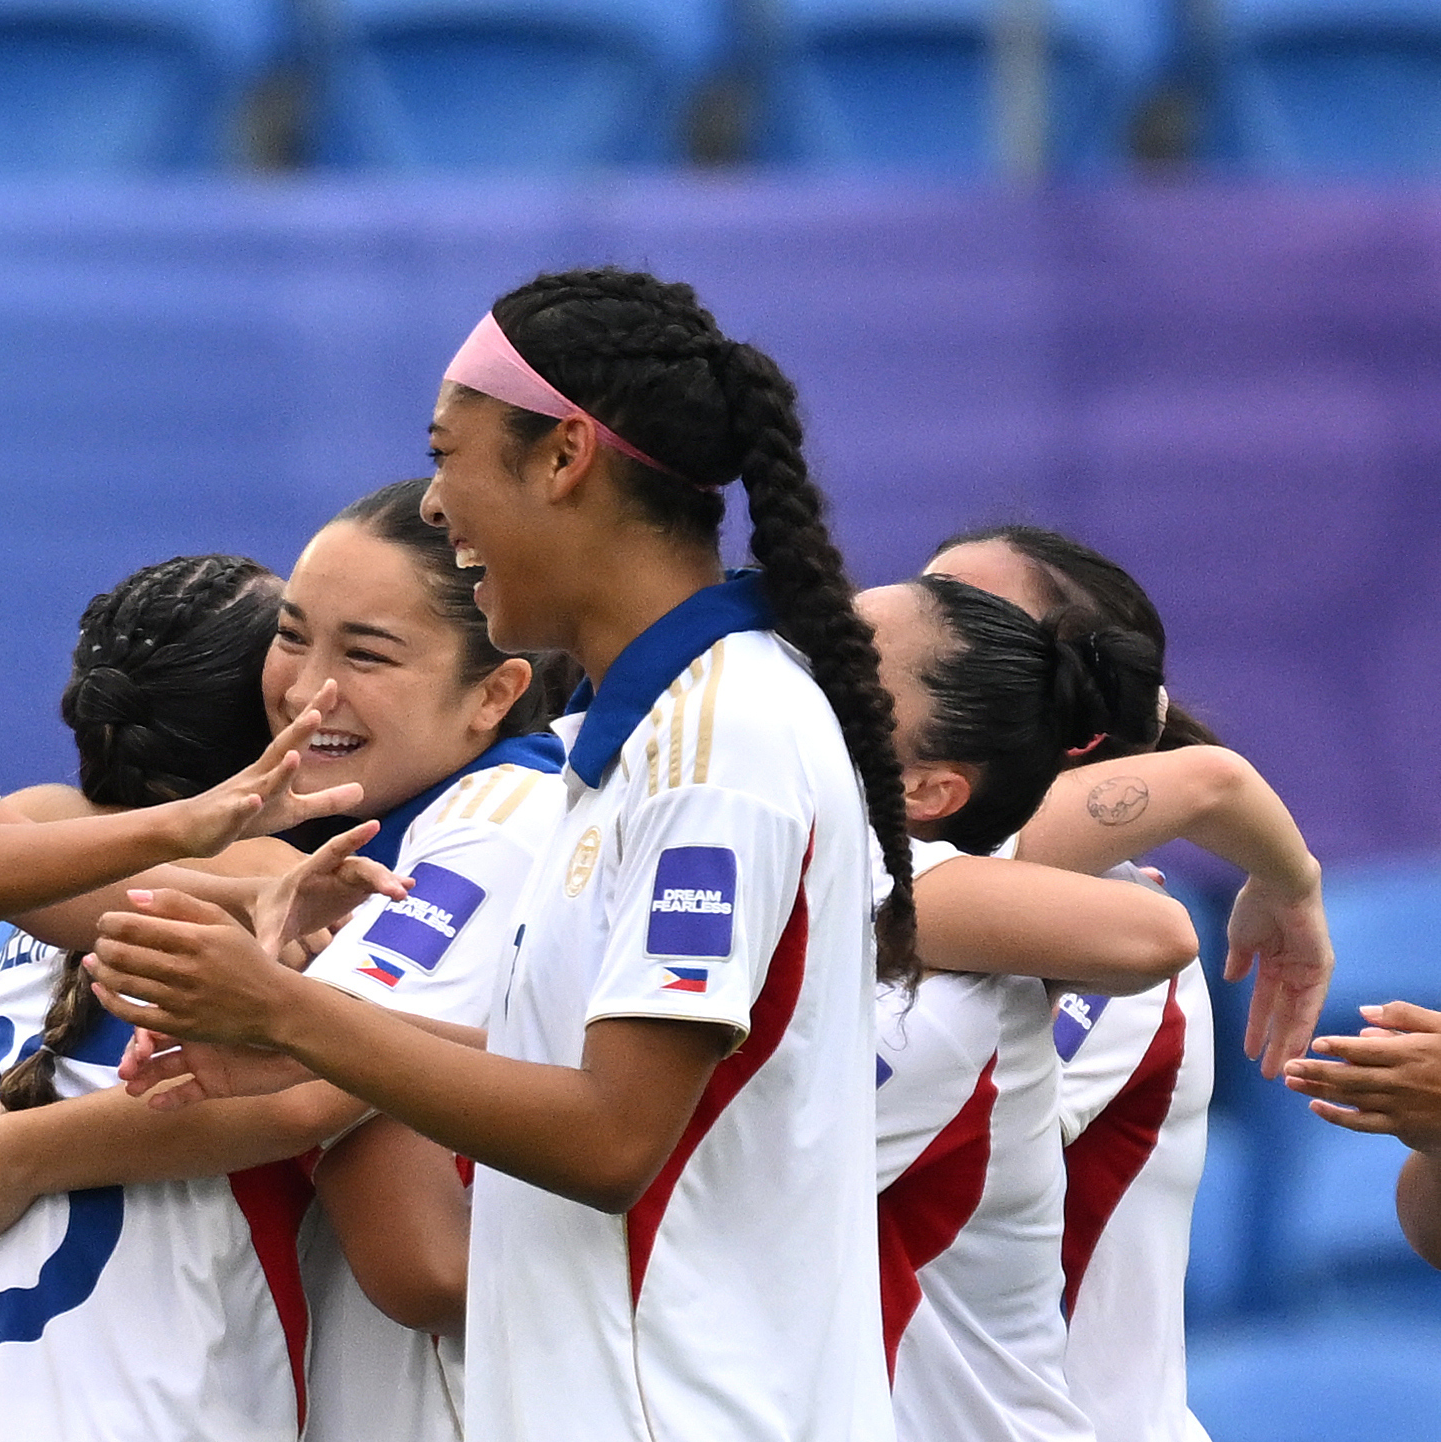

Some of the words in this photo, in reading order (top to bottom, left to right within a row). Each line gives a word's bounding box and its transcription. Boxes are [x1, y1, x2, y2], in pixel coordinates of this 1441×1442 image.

[663, 889, 722, 902] DREAM
[652, 900, 732, 914] FEARLESS
[385, 901, 456, 938] FEARLESS
